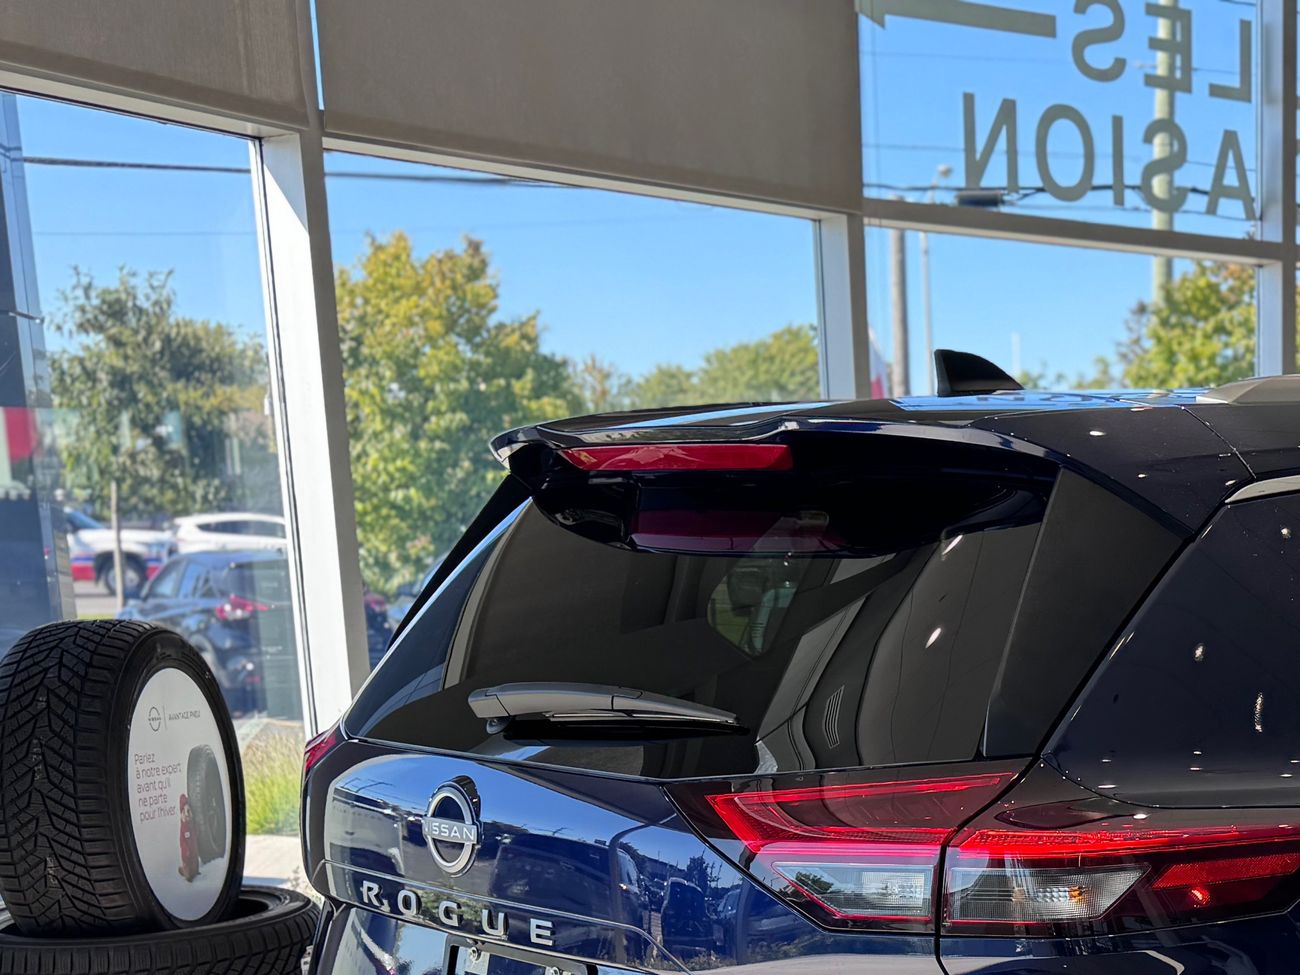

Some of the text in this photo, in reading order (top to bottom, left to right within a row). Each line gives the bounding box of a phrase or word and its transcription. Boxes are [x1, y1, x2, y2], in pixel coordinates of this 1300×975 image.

[134, 753, 156, 766] Parlez
[136, 763, 182, 779] à notre expert
[137, 780, 157, 794] avant
[138, 793, 168, 807] ne parte
[140, 810, 157, 823] pour
[361, 880, 554, 946] ROGUE
